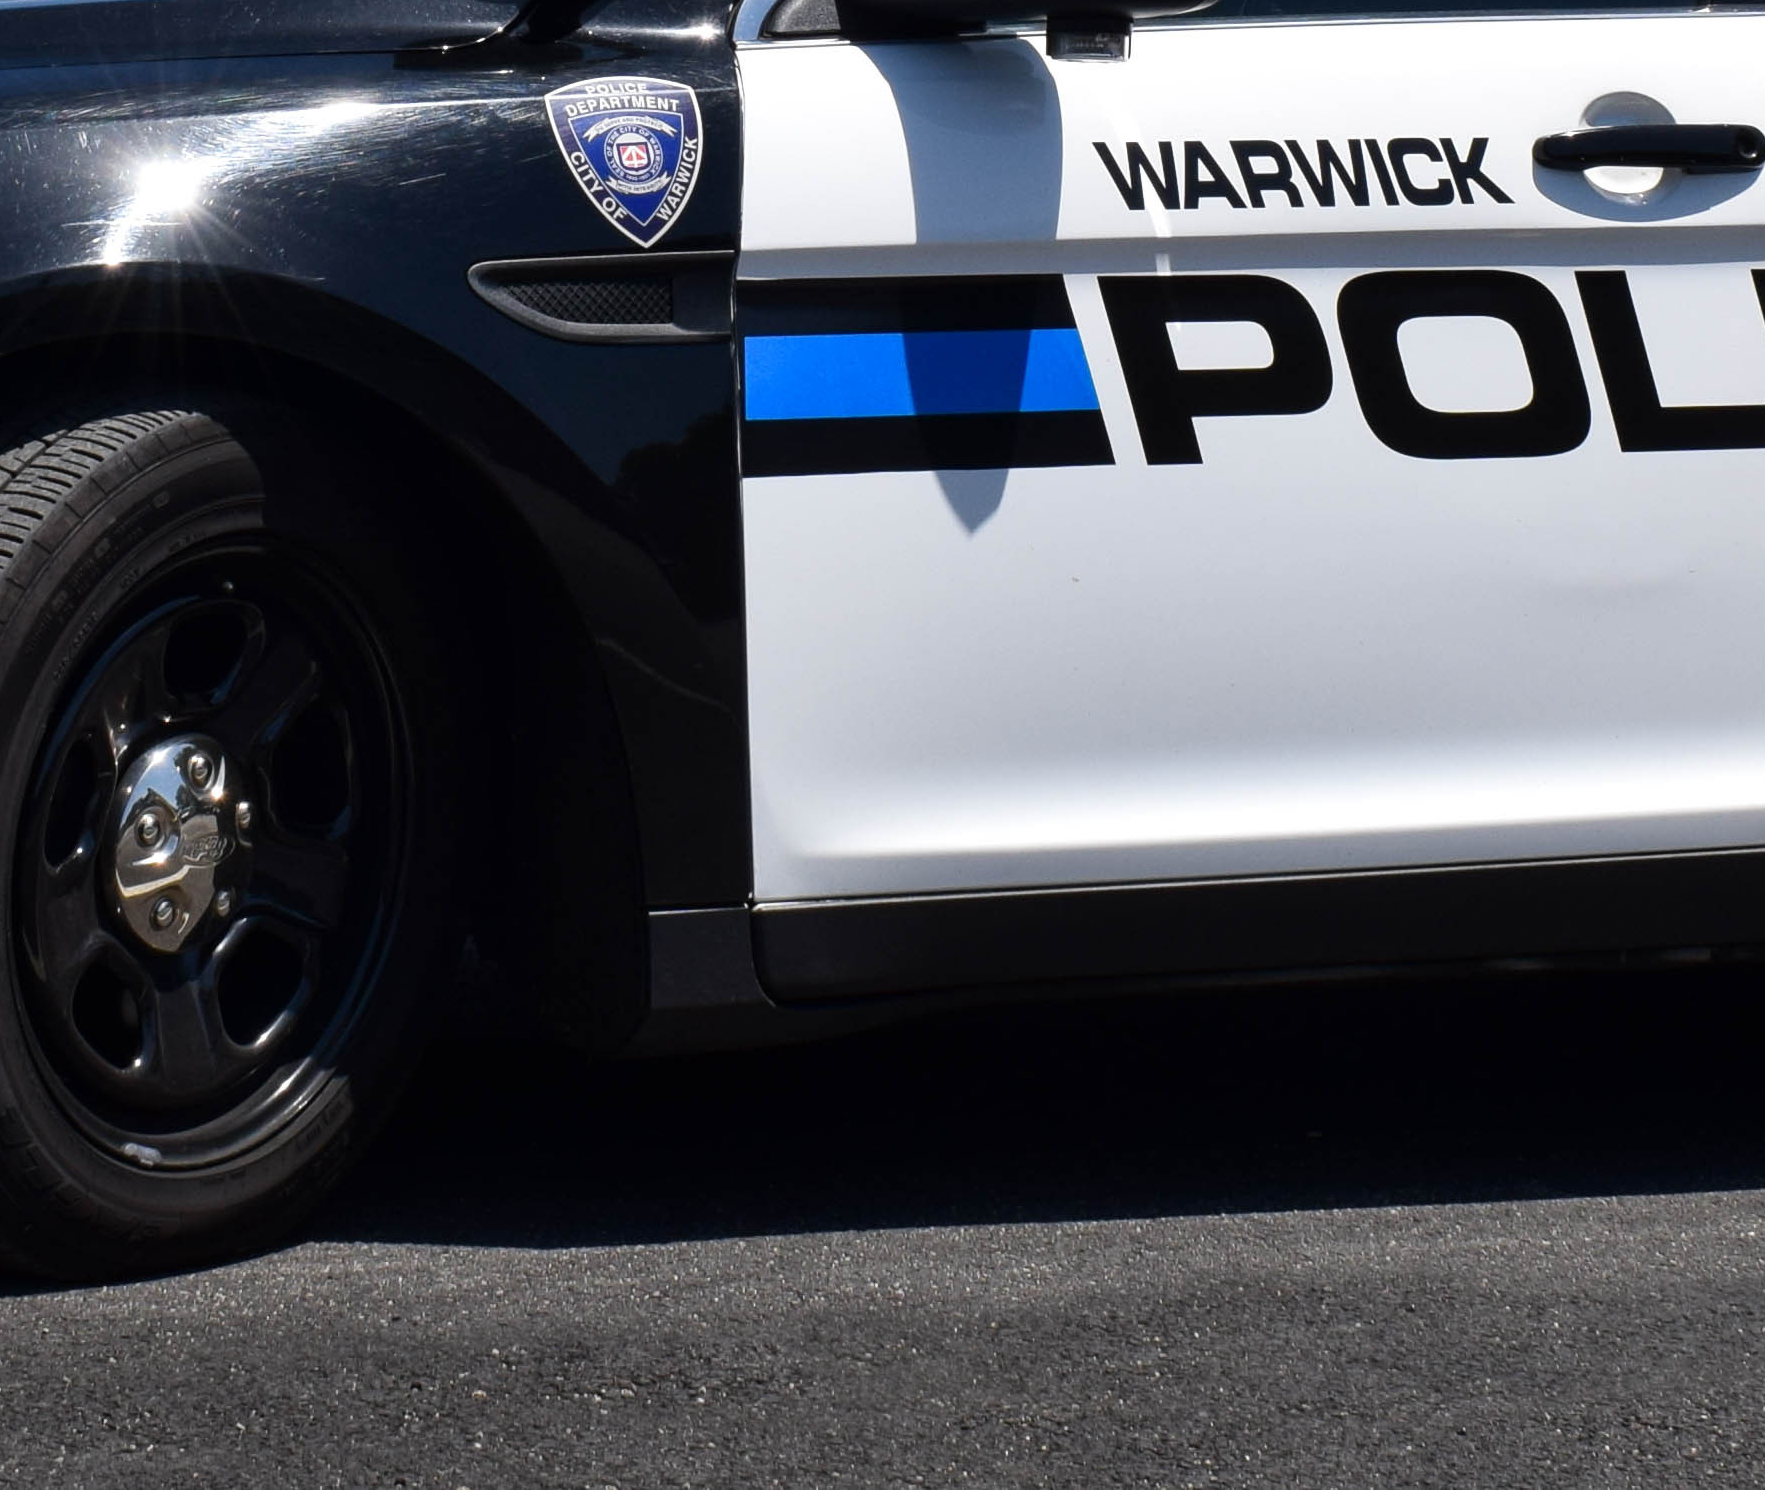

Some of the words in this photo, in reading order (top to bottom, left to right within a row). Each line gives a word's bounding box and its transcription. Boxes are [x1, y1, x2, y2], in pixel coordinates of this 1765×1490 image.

[566, 97, 679, 116] DEPARTMENT
[585, 83, 647, 95] POLICE
[570, 151, 603, 194] CITY
[602, 196, 627, 221] OF
[656, 136, 698, 221] WARWICK
[1092, 137, 1515, 210] WARWICK
